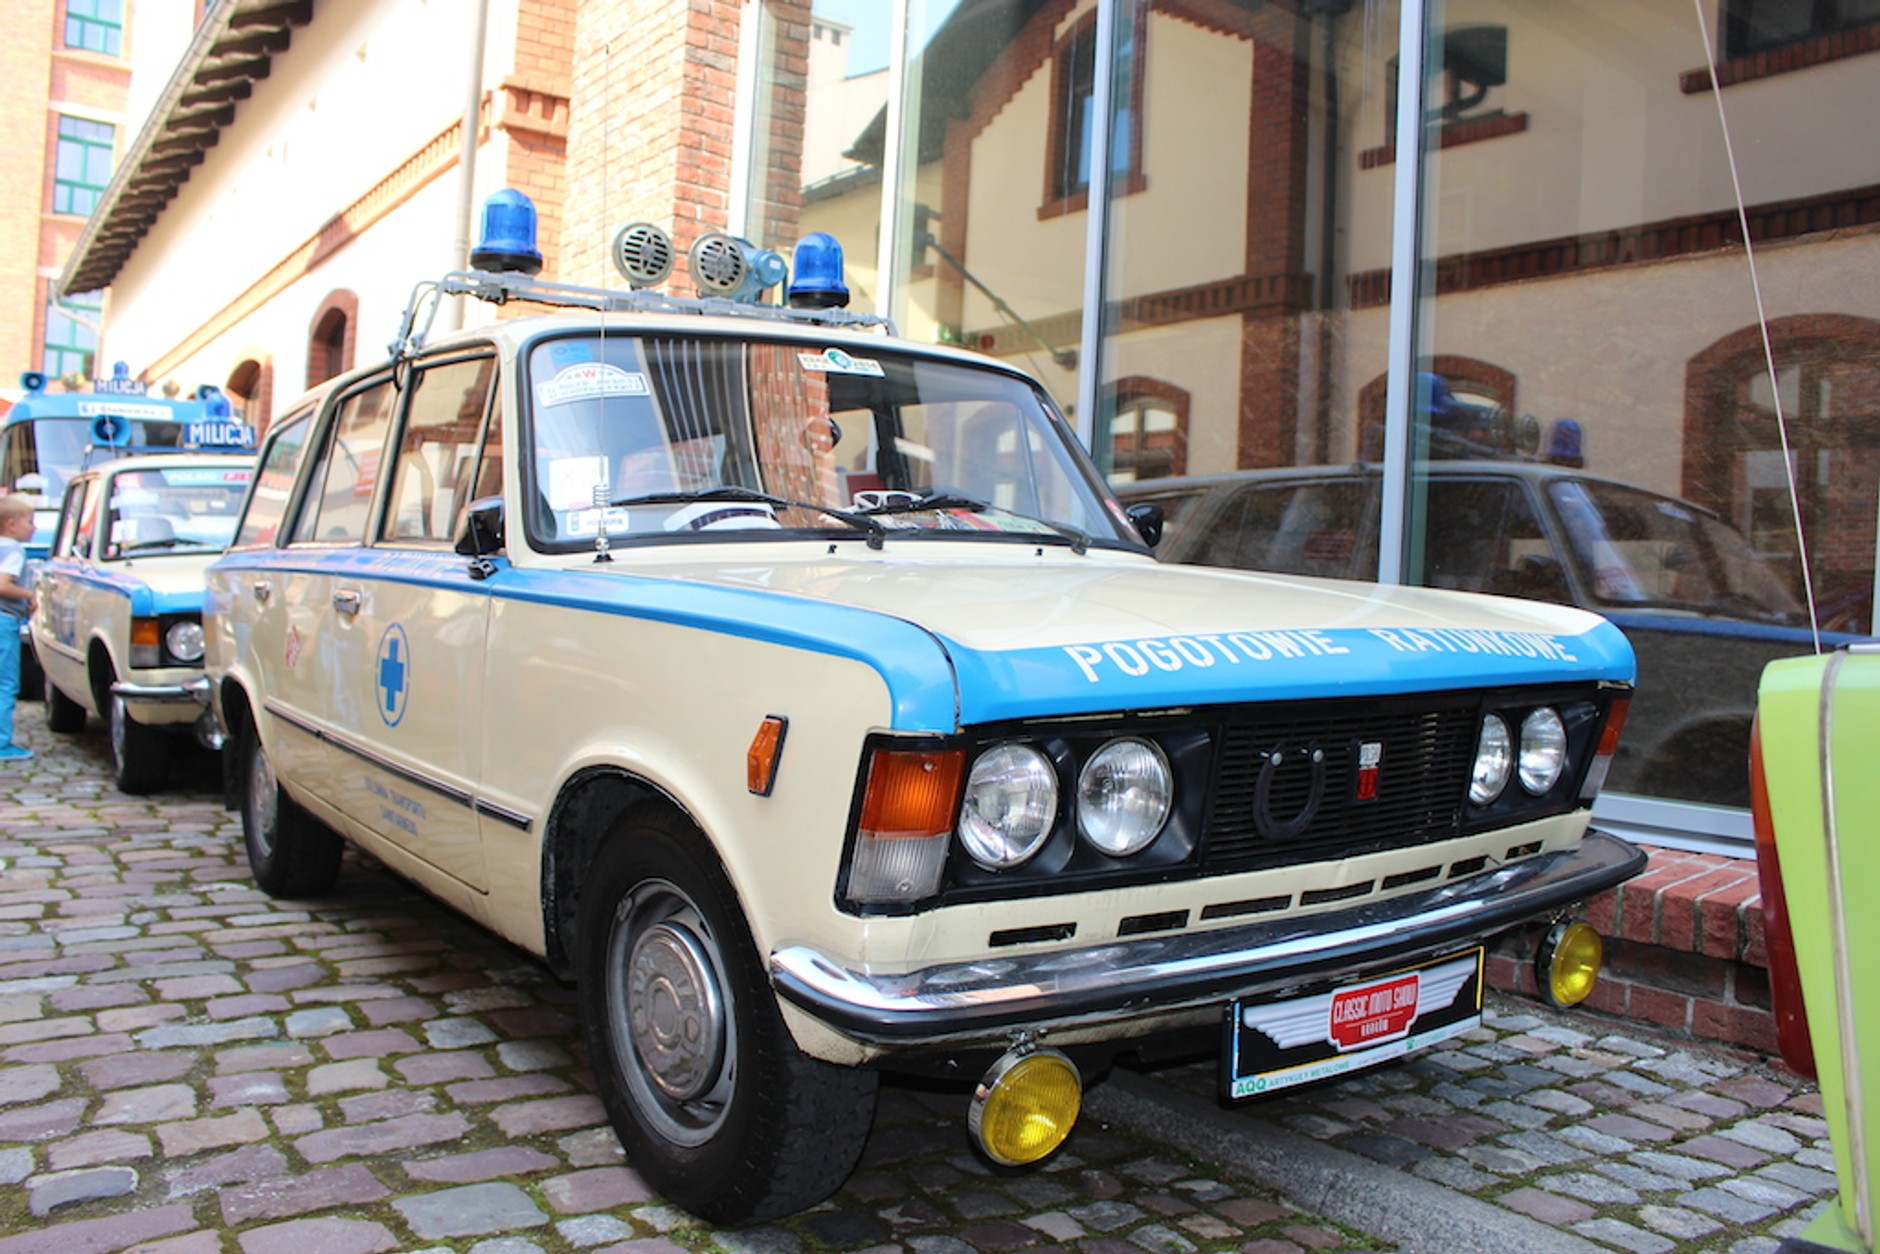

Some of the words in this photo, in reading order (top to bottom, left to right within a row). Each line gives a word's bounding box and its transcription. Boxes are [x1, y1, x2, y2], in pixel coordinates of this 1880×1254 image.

[96, 380, 145, 394] MILICJA
[190, 423, 253, 445] MILICJA
[1063, 629, 1350, 682] POGOTOWIE
[1369, 629, 1578, 662] RATUNKOWE
[1333, 995, 1369, 1023] CLASSIC
[1394, 983, 1417, 1009] SHOW
[1236, 1078, 1267, 1095] AQQ
